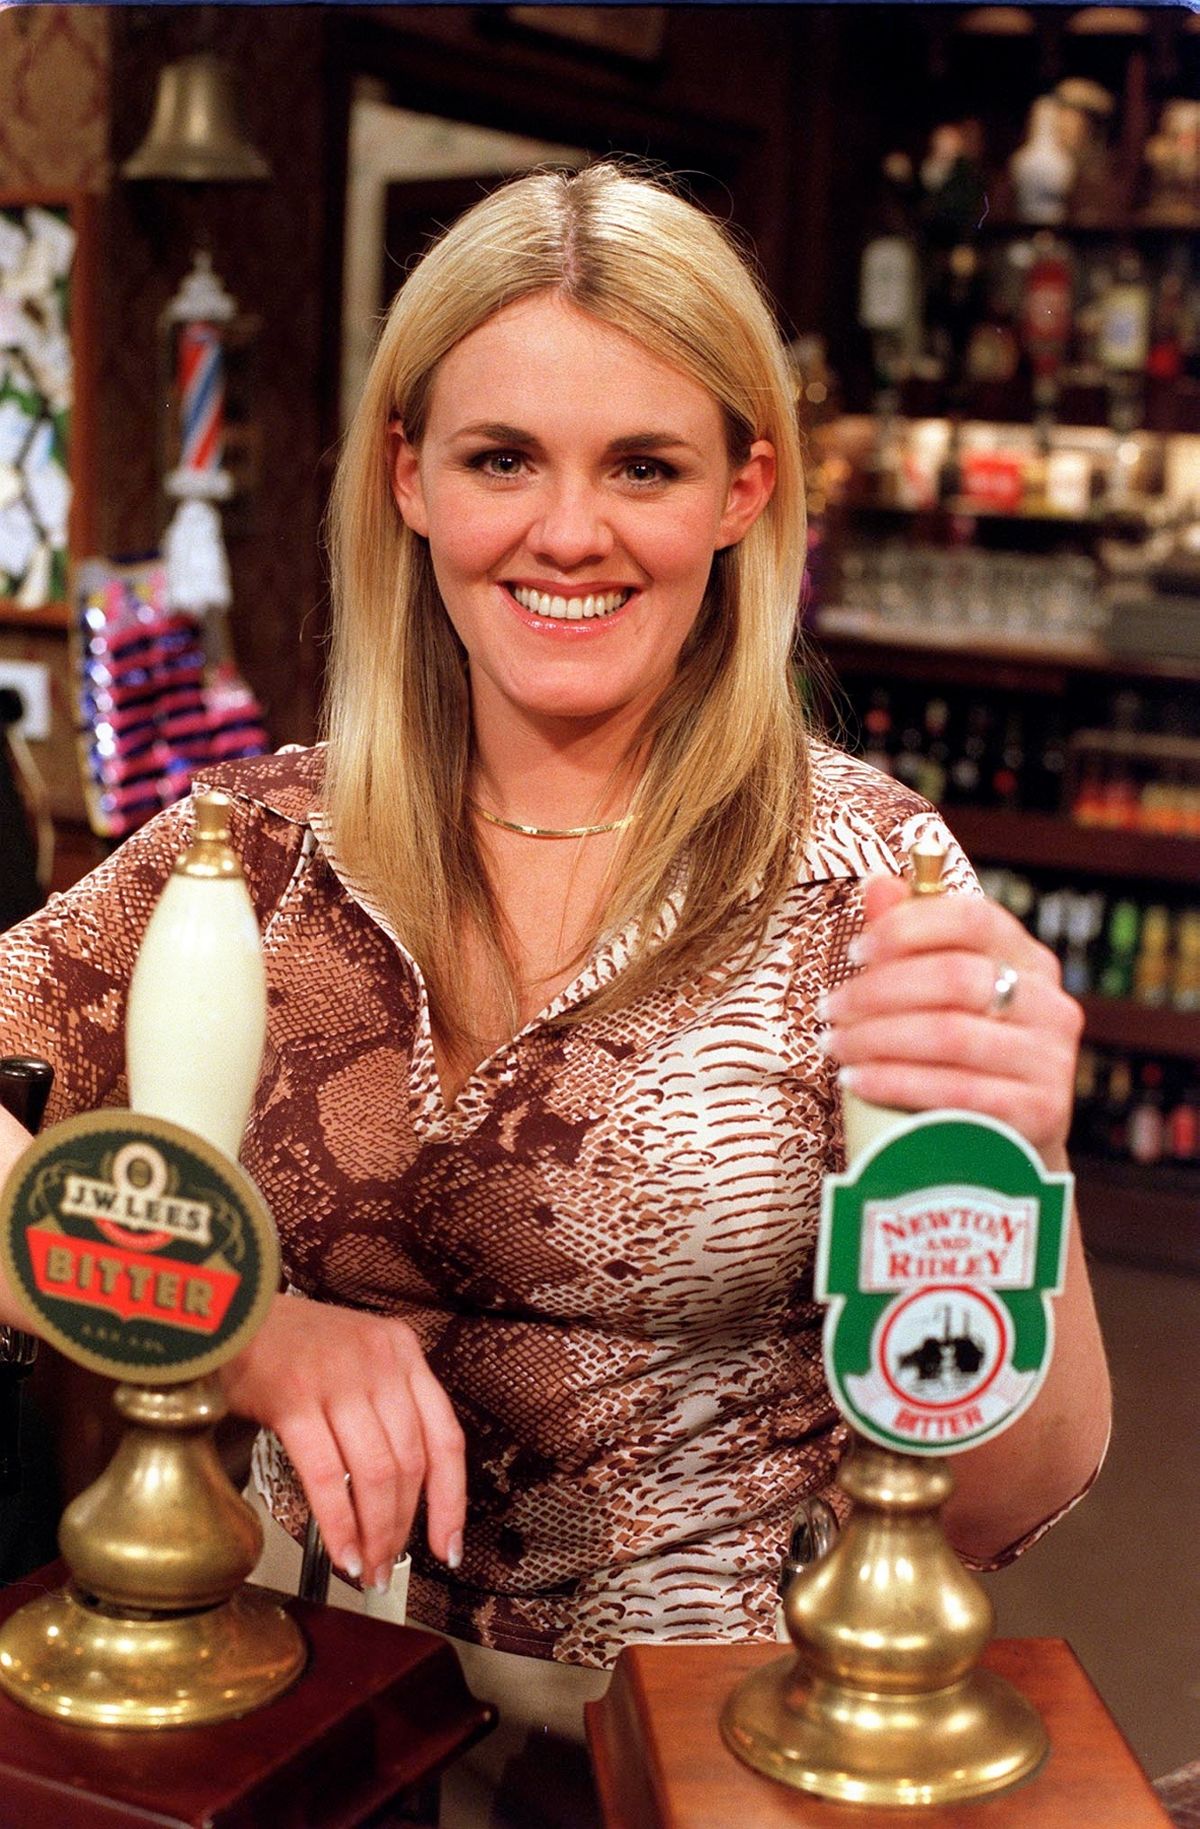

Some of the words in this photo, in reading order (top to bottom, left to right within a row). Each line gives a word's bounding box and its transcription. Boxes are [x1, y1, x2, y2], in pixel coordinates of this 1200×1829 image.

[880, 1207, 1022, 1246] NEWTON
[887, 1250, 1008, 1278] RIDLEY
[46, 1245, 214, 1318] BITTER
[892, 1407, 985, 1436] BITTER
